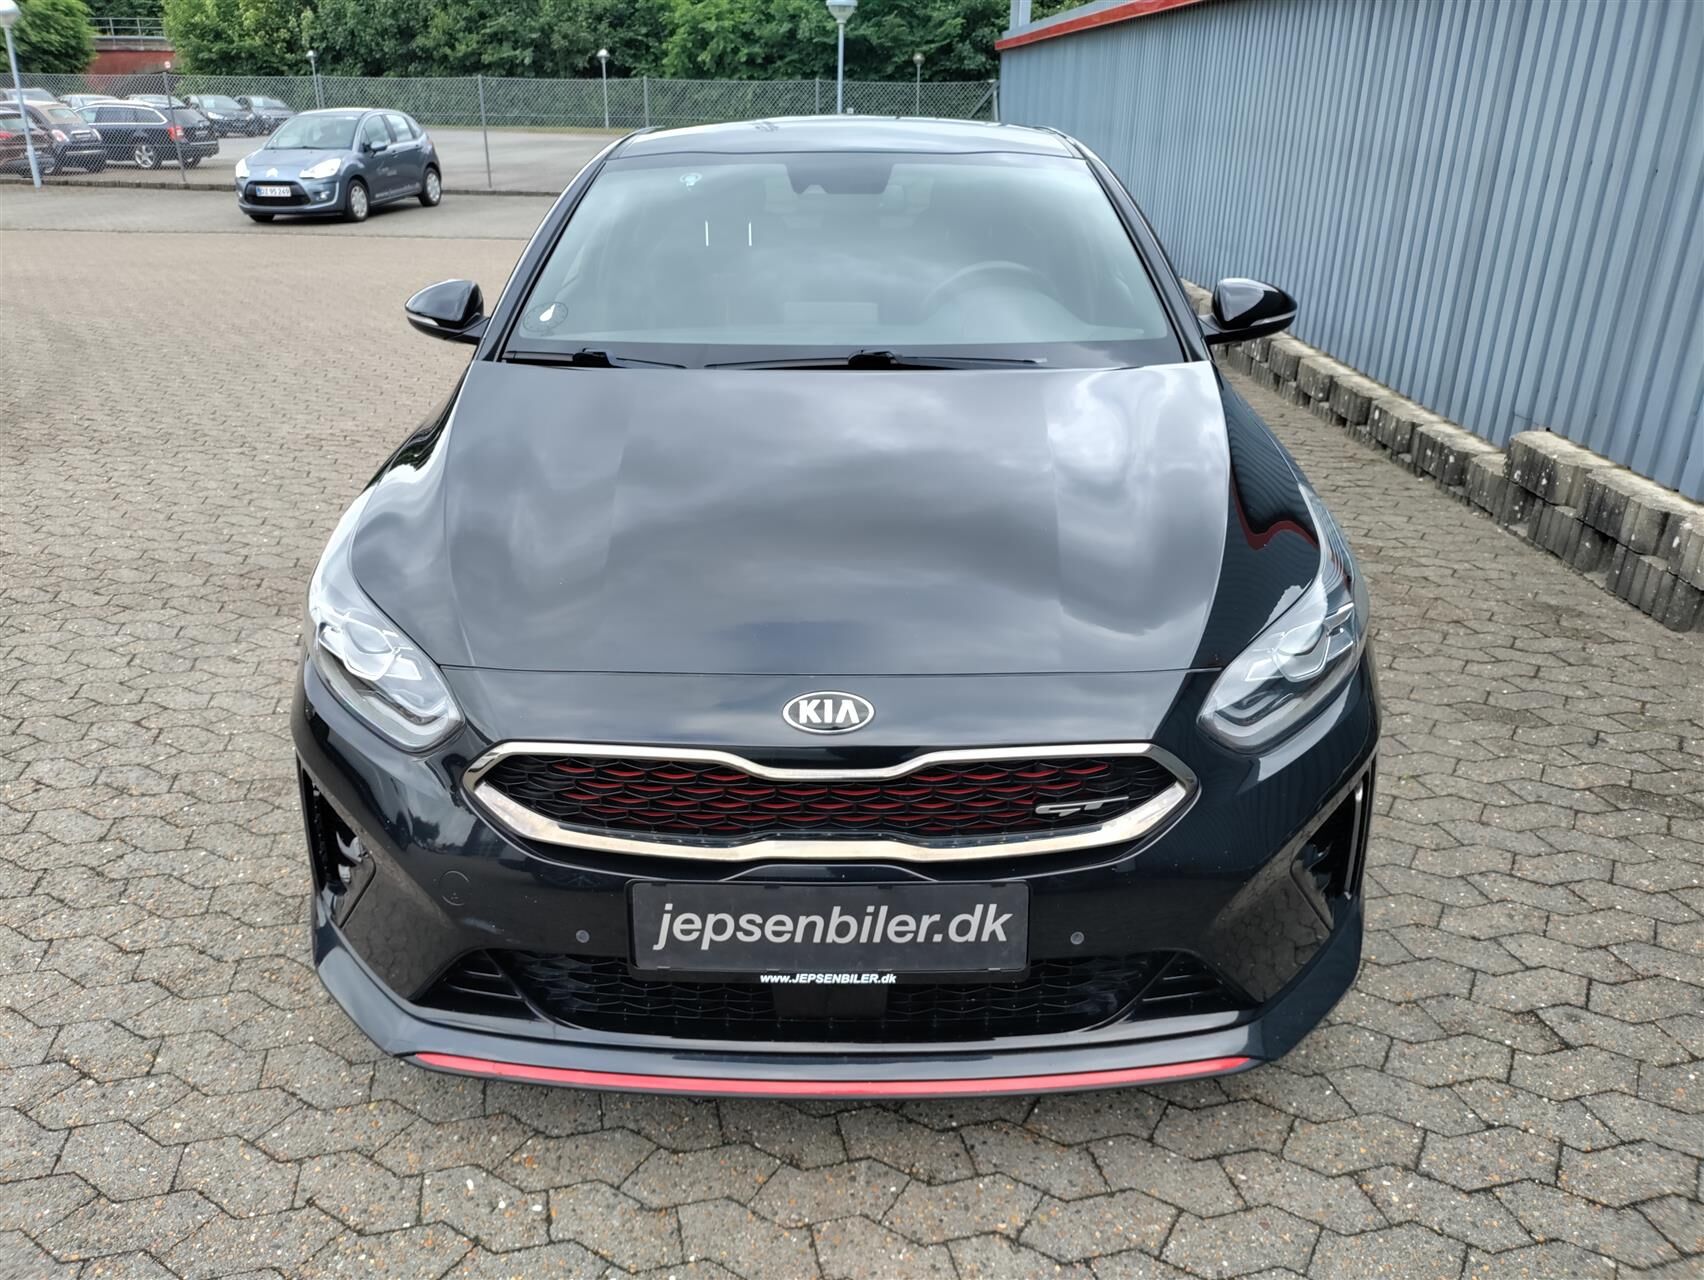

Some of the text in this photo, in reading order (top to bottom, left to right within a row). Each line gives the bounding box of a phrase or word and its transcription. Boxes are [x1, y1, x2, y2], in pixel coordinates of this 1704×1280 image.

[798, 698, 861, 724] KIA
[652, 903, 1013, 951] jepsenbiler.dk
[759, 973, 897, 985] www.JEPSENBILER.dk
